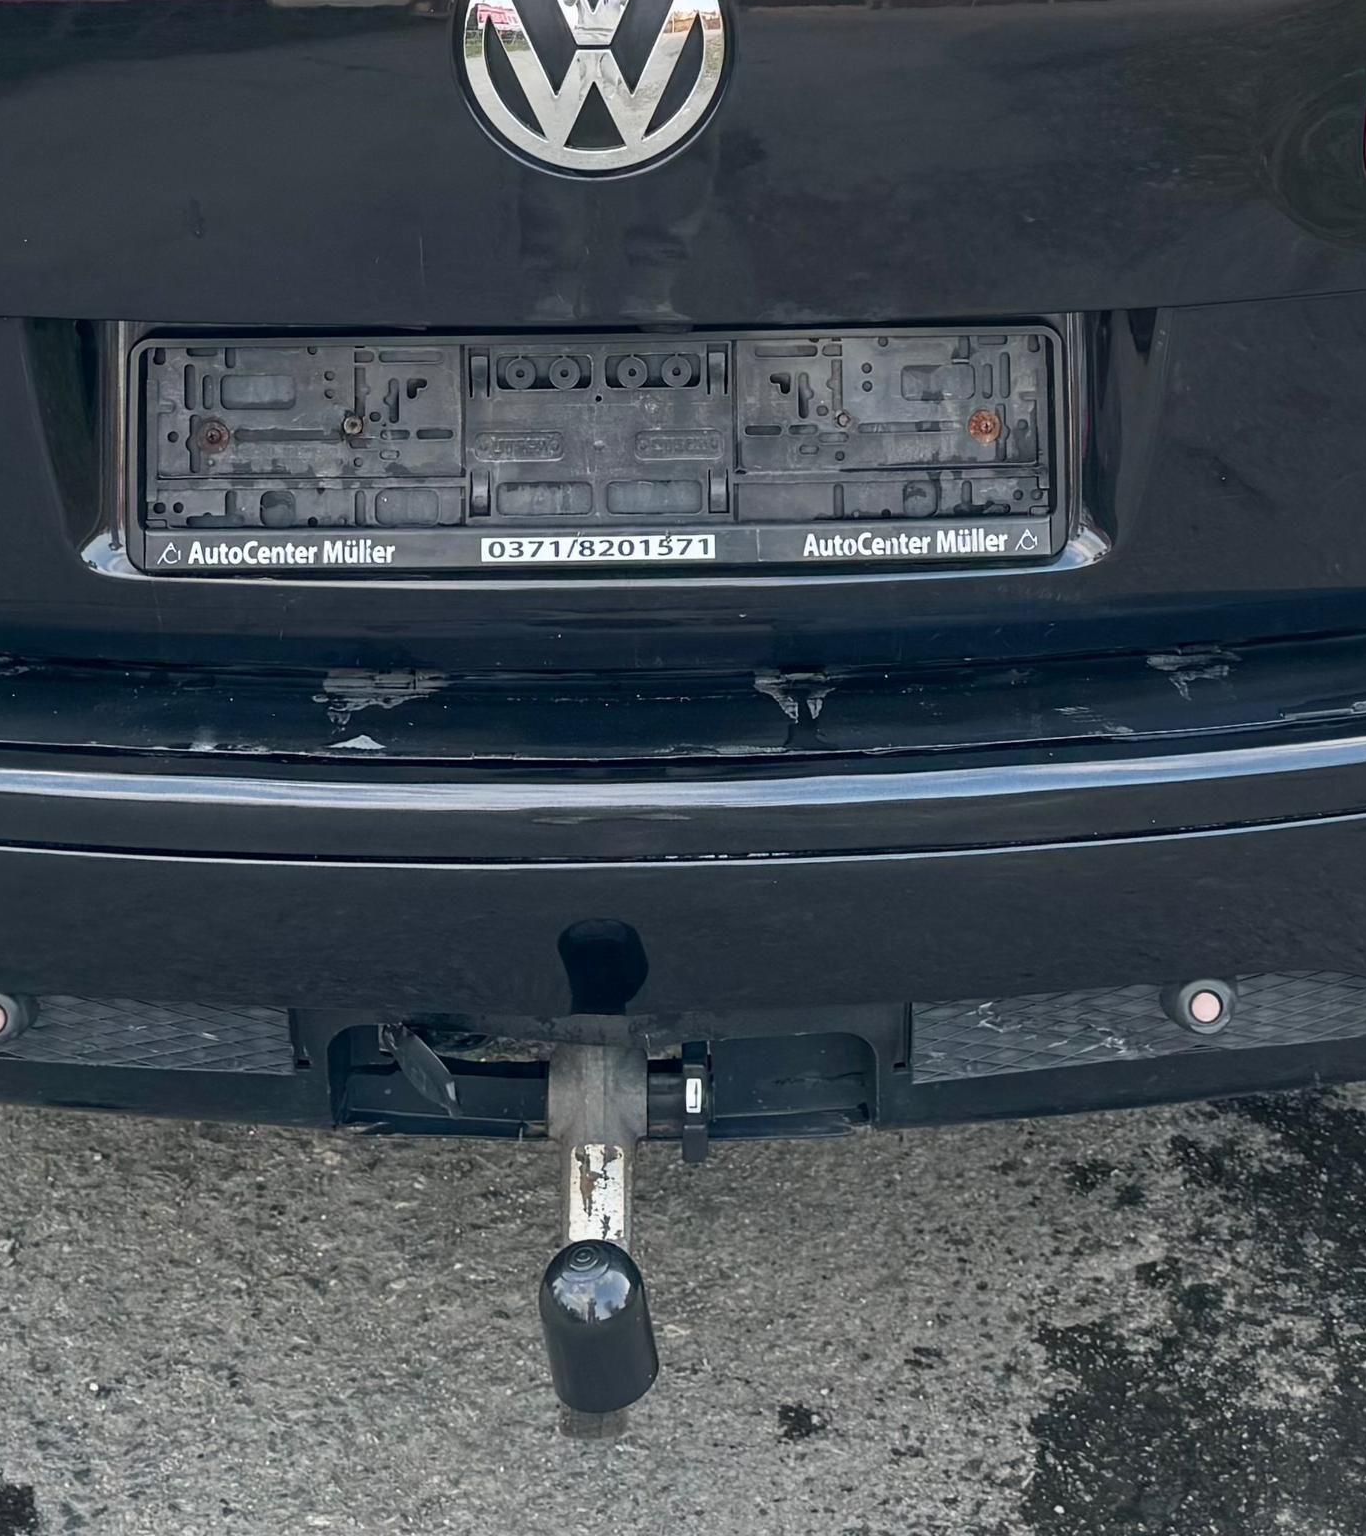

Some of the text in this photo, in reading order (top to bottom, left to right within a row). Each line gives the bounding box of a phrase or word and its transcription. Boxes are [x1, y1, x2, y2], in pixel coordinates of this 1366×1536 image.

[187, 539, 318, 565] AutoCenter
[322, 538, 396, 564] Müller
[488, 538, 710, 559] 0371/8201571
[803, 531, 932, 557] AutoCenter
[936, 528, 1008, 554] Müller
